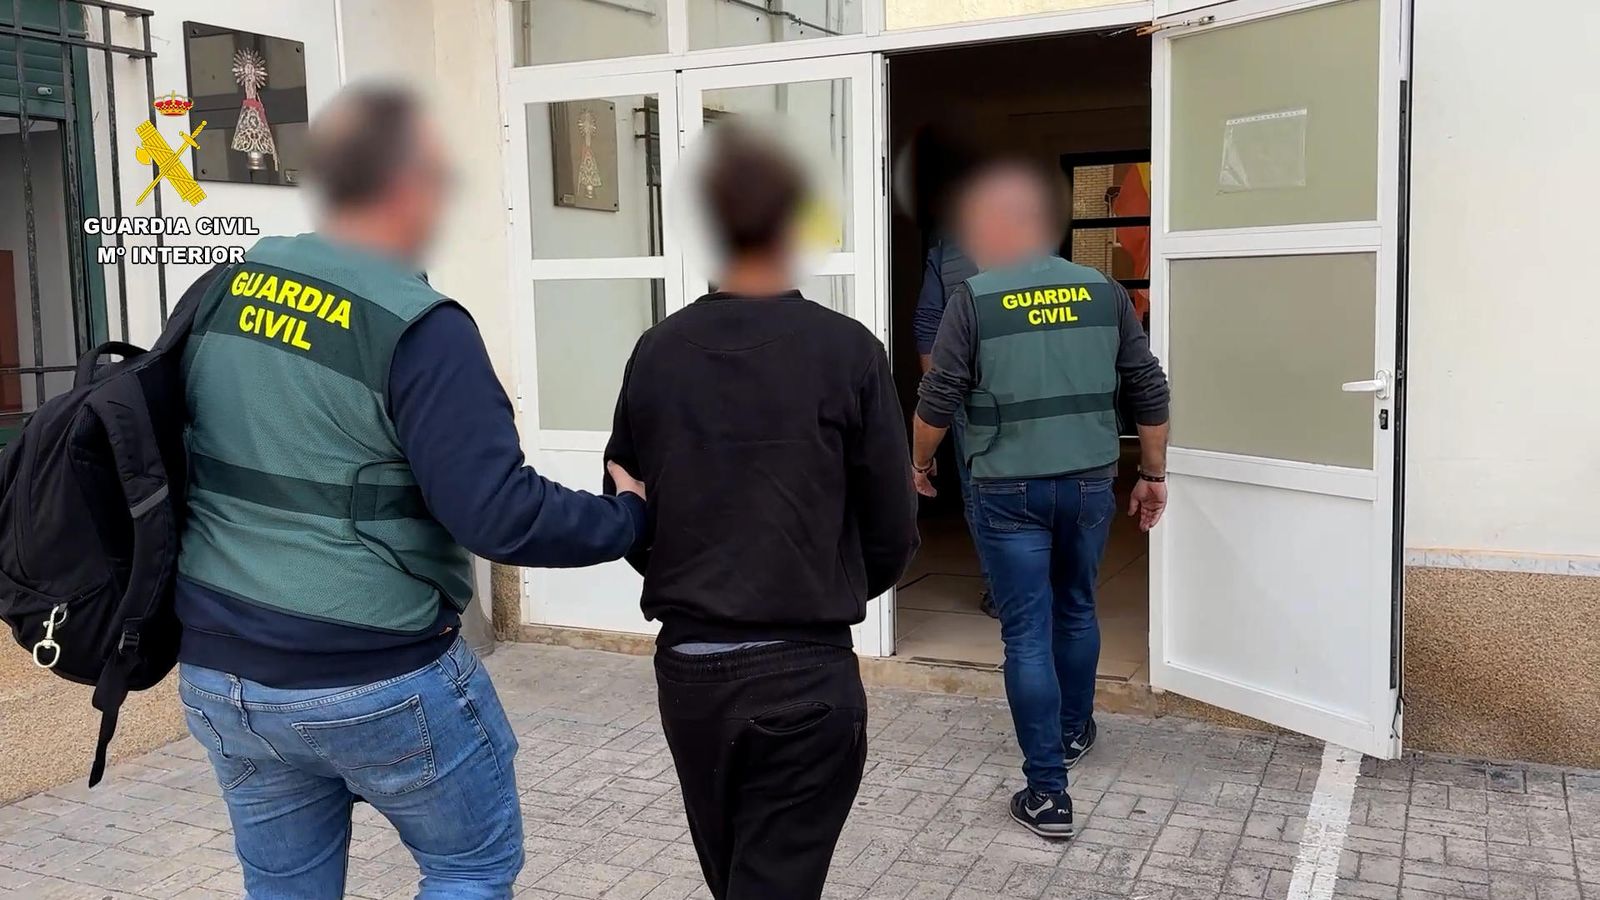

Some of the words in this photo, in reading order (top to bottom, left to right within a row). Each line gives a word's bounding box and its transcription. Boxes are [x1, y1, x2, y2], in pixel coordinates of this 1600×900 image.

[231, 271, 351, 329] GUARDIA
[1002, 287, 1092, 310] GUARDIA
[1028, 306, 1078, 325] CIVIL
[239, 305, 312, 350] CIVIL
